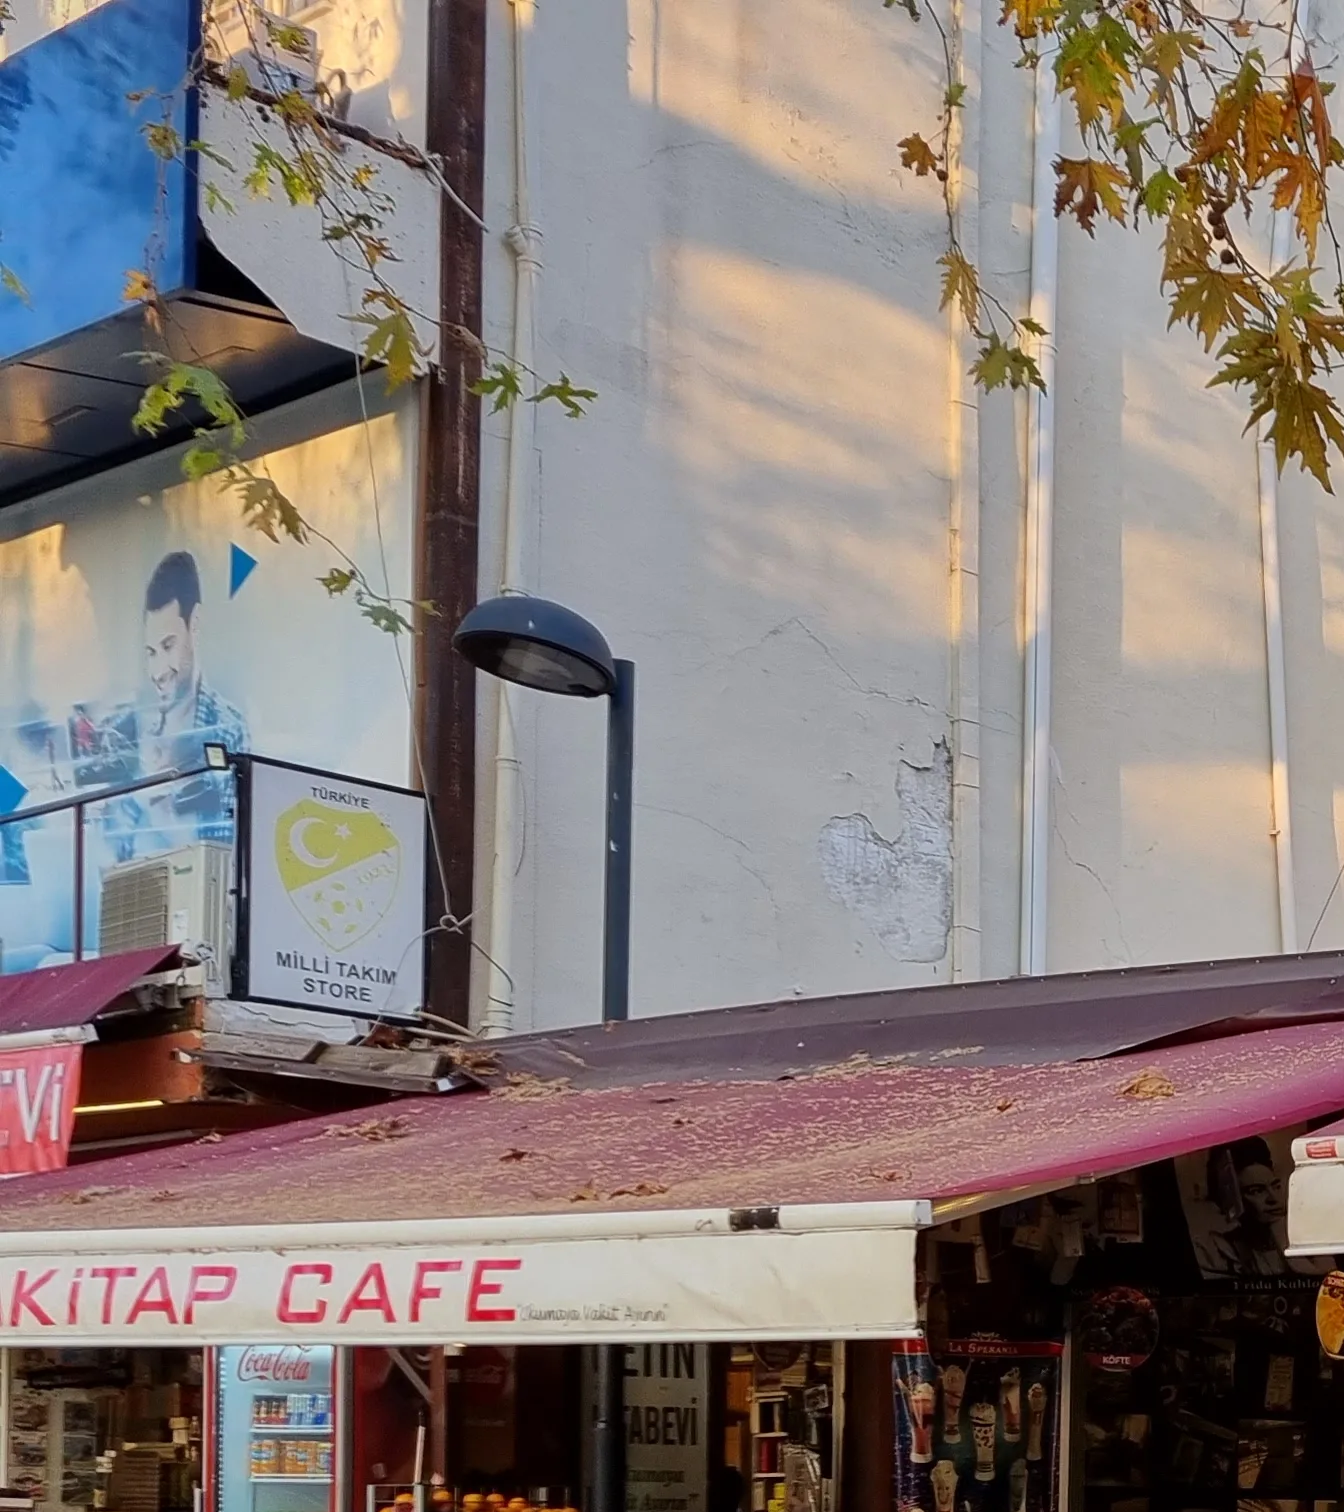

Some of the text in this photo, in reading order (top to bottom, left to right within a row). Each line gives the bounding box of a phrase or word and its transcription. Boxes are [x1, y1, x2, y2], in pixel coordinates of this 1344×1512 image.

[310, 785, 370, 809] TÜRKİYE
[276, 950, 397, 985] MİLLİ TAKIM
[303, 977, 373, 1002] STORE
[276, 1259, 523, 1324] CAFE
[1102, 1354, 1131, 1366] KÖFTE
